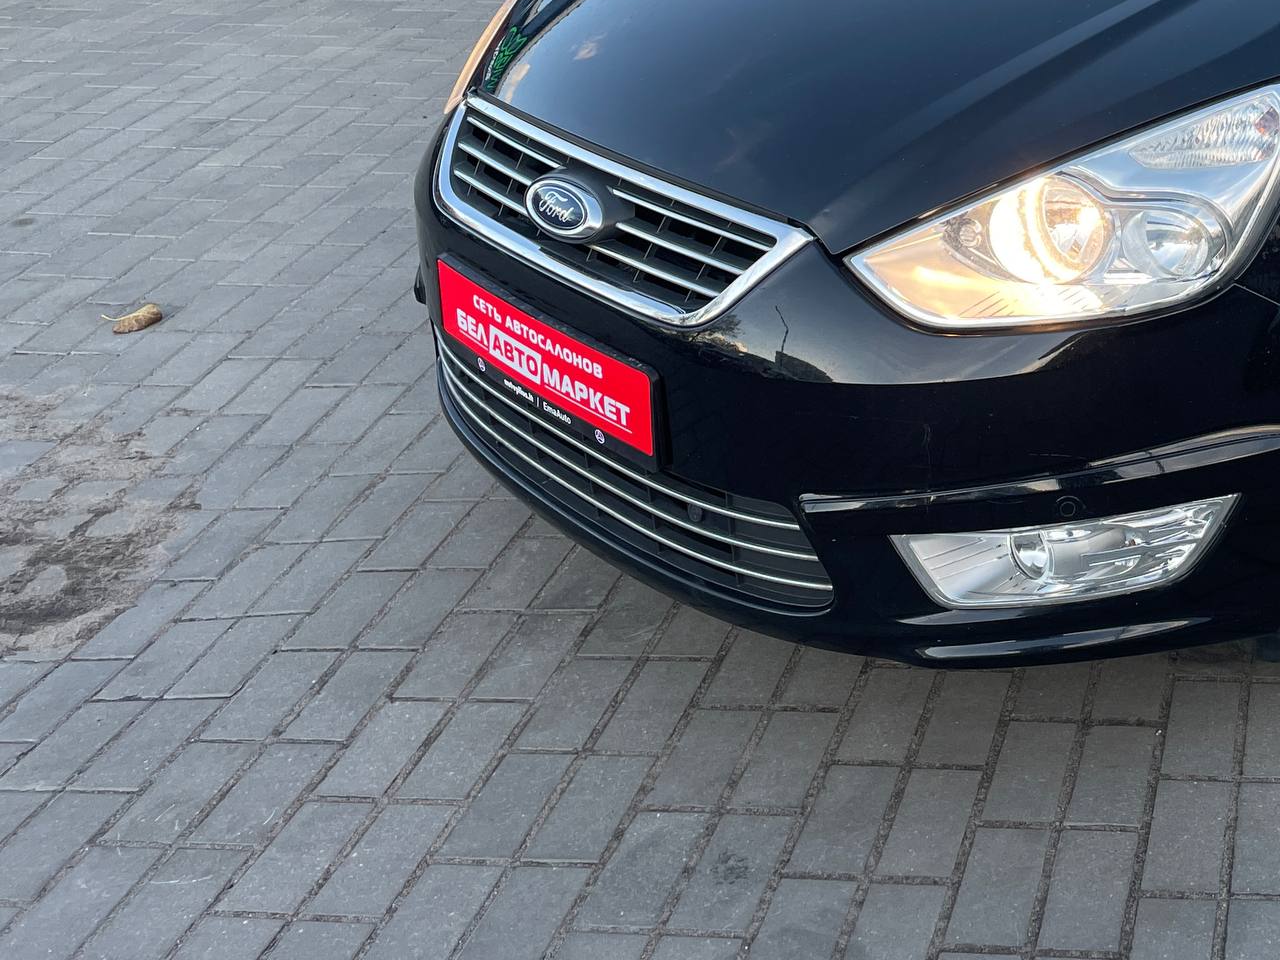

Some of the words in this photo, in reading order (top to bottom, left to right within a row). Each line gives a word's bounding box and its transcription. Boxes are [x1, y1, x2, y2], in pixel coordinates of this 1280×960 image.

[538, 191, 576, 222] Ford
[457, 308, 488, 346] БЕЛ
[492, 330, 540, 378] АВТО
[543, 363, 631, 426] МАРКЕТ
[473, 294, 502, 323] СЕТЬ
[505, 316, 603, 379] АВТОСАЛОНОВ
